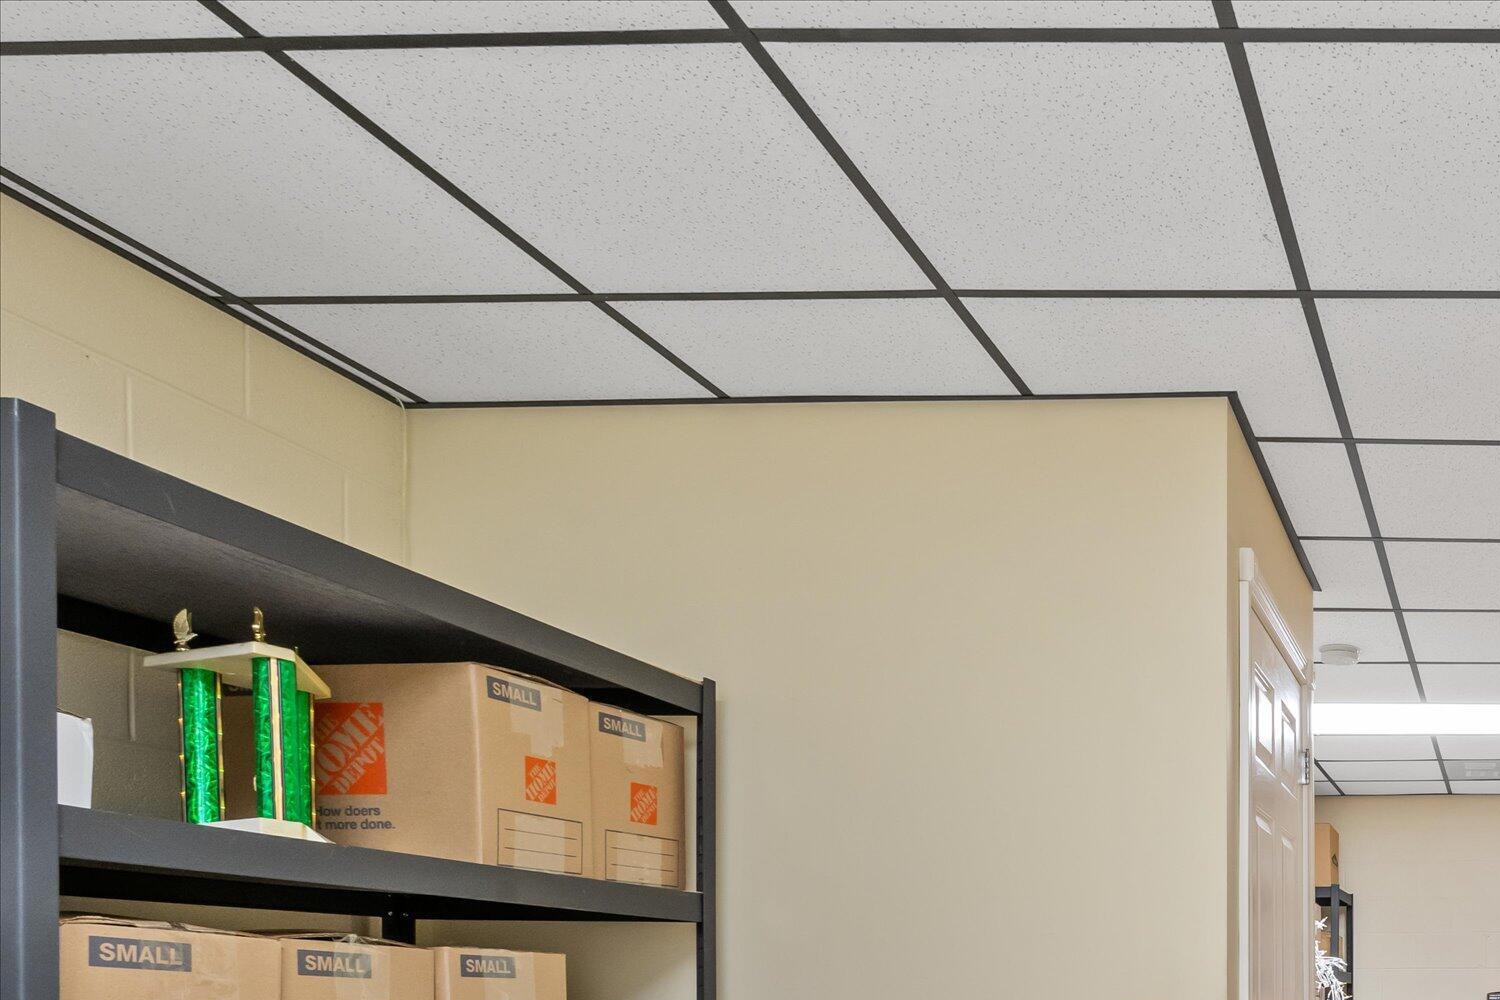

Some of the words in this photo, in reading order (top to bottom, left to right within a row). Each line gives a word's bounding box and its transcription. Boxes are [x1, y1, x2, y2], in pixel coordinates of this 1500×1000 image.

[492, 681, 537, 707] SMALL
[603, 717, 642, 737] SMALL
[345, 806, 381, 816] doers
[325, 820, 357, 830] more
[360, 818, 396, 830] done.
[99, 942, 183, 966] SMALL
[305, 955, 365, 973] SMALL
[466, 959, 511, 974] SMALL
